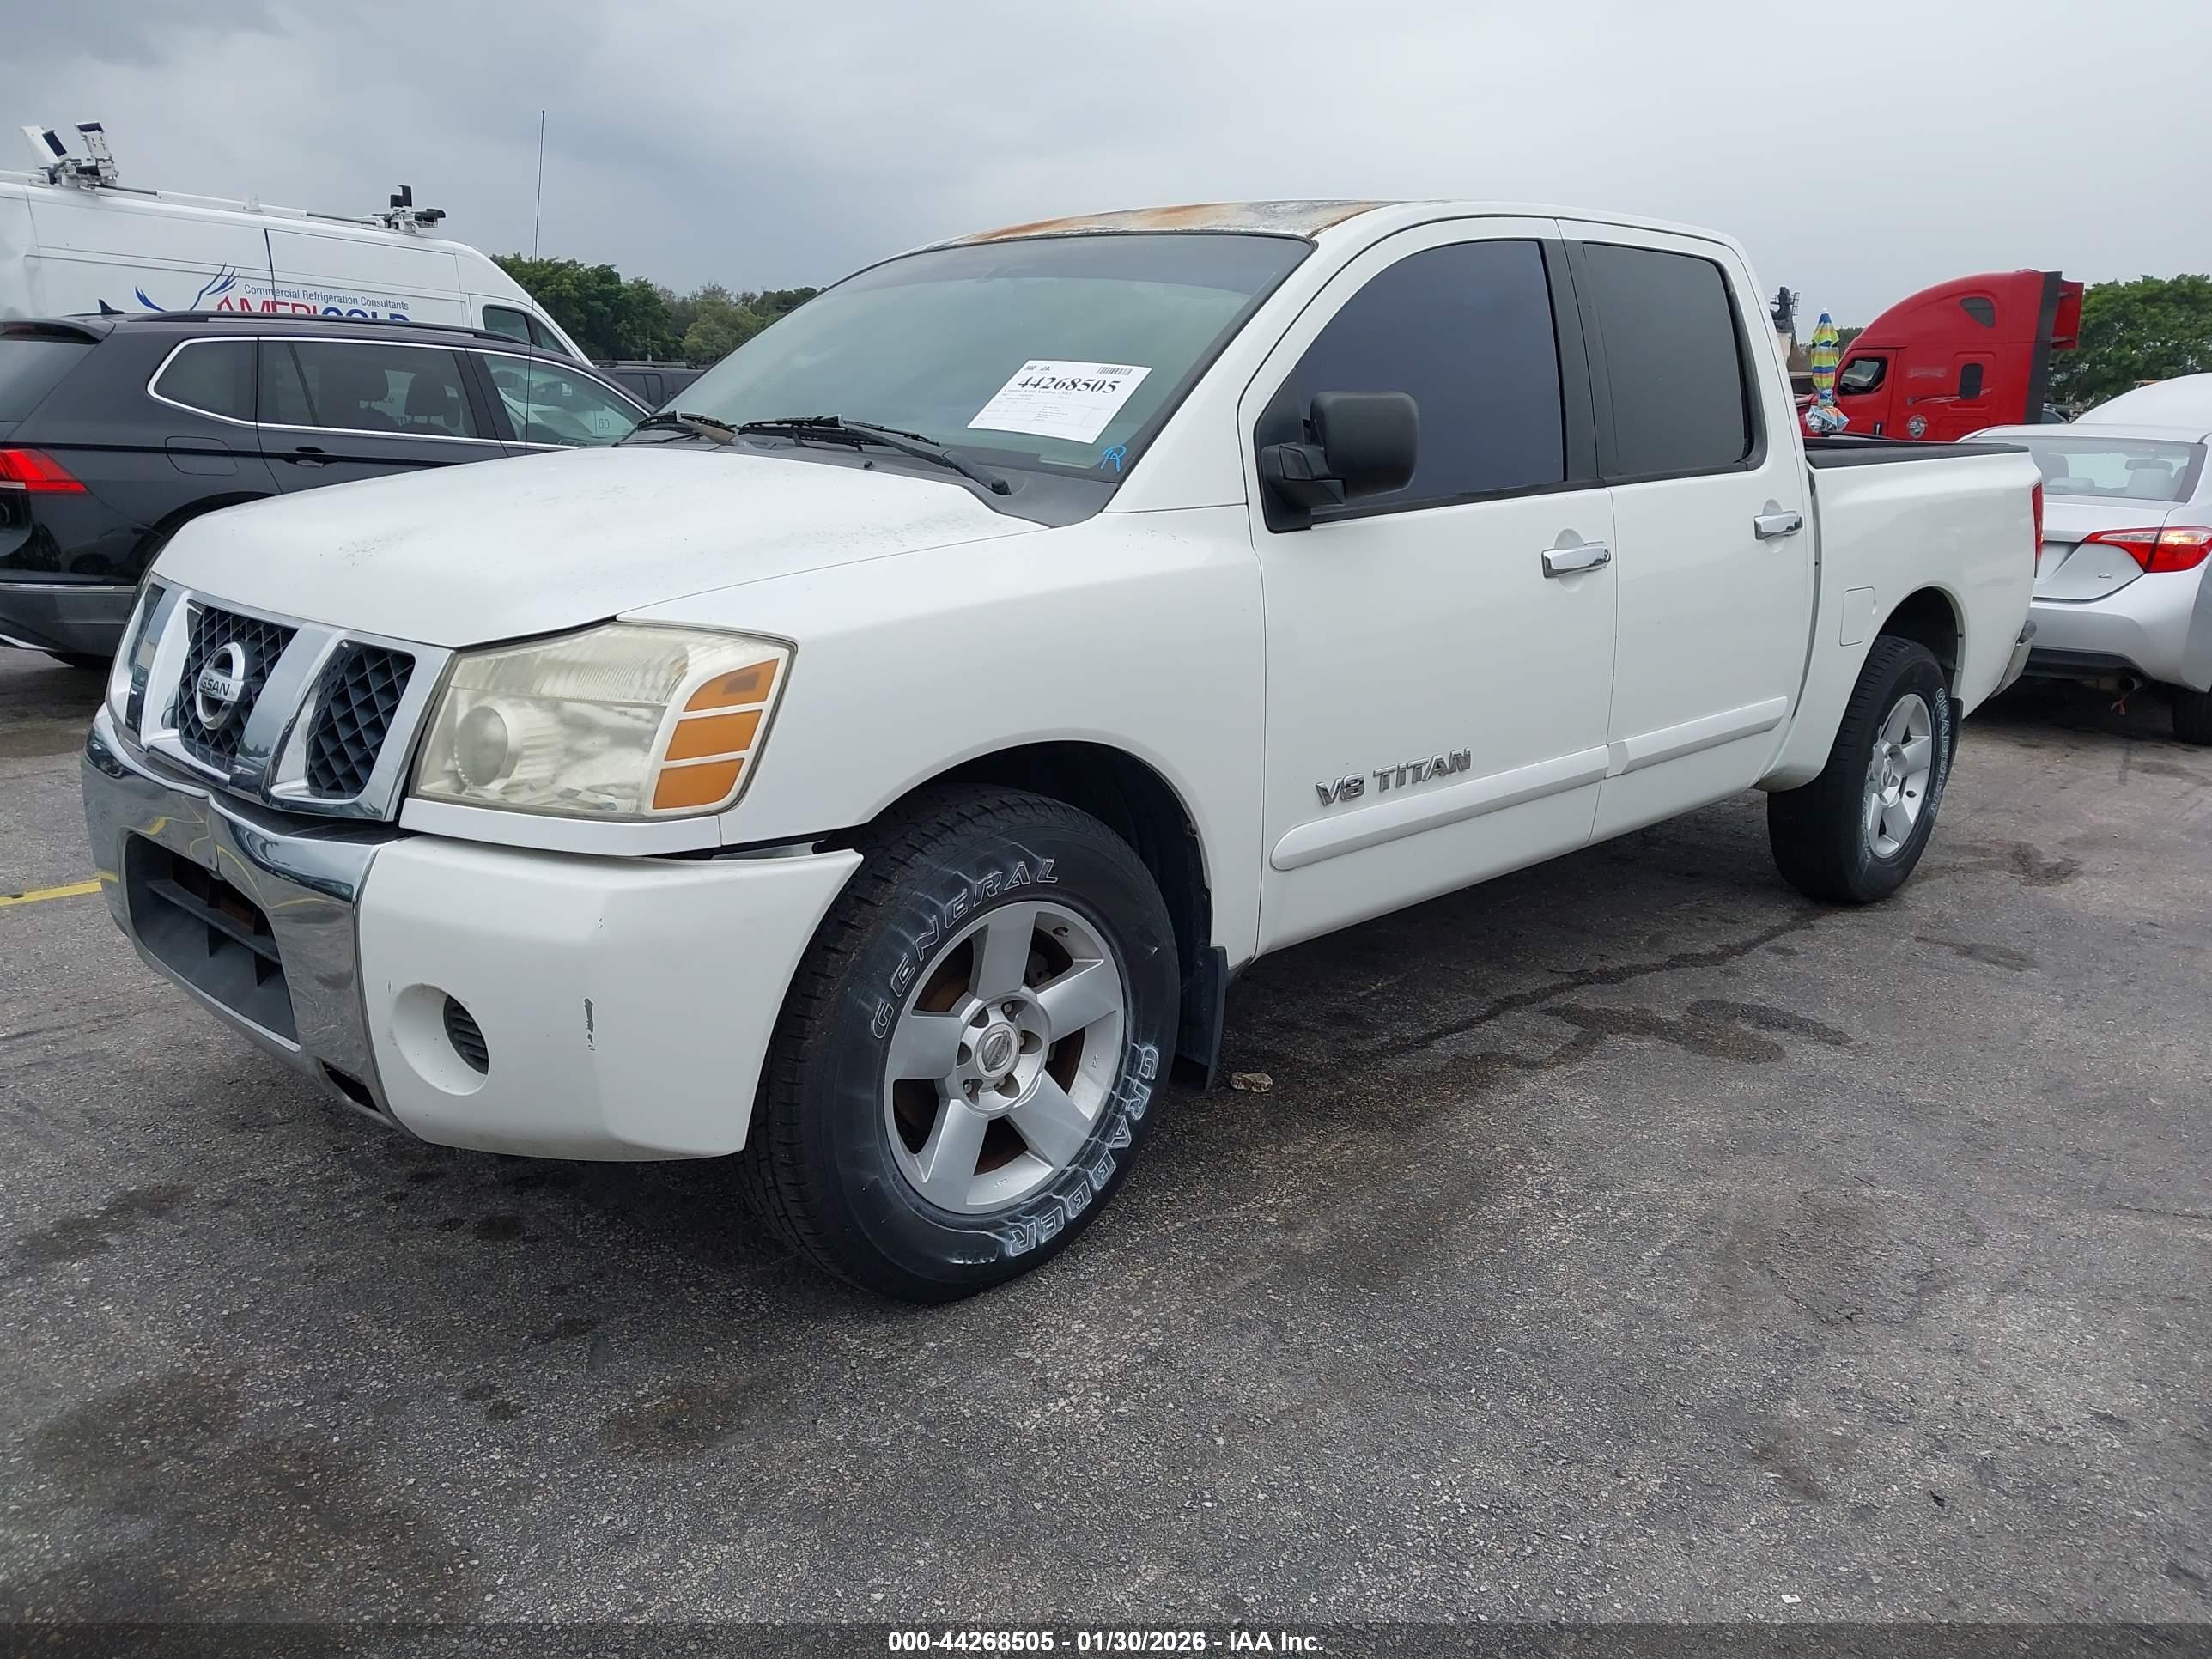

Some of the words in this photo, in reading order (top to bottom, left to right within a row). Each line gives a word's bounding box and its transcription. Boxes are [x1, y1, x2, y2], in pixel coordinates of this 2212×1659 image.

[244, 283, 300, 299] Commercial
[302, 290, 358, 306] Refrigeration
[360, 296, 410, 311] Consultants
[1018, 376, 1121, 394] 44268505
[598, 418, 610, 429] 60
[199, 677, 231, 696] SSAN
[1315, 773, 1365, 806] V8
[1373, 747, 1472, 793] TITAN
[870, 857, 1060, 1040] GENERAL
[1008, 1043, 1161, 1258] GRABBER
